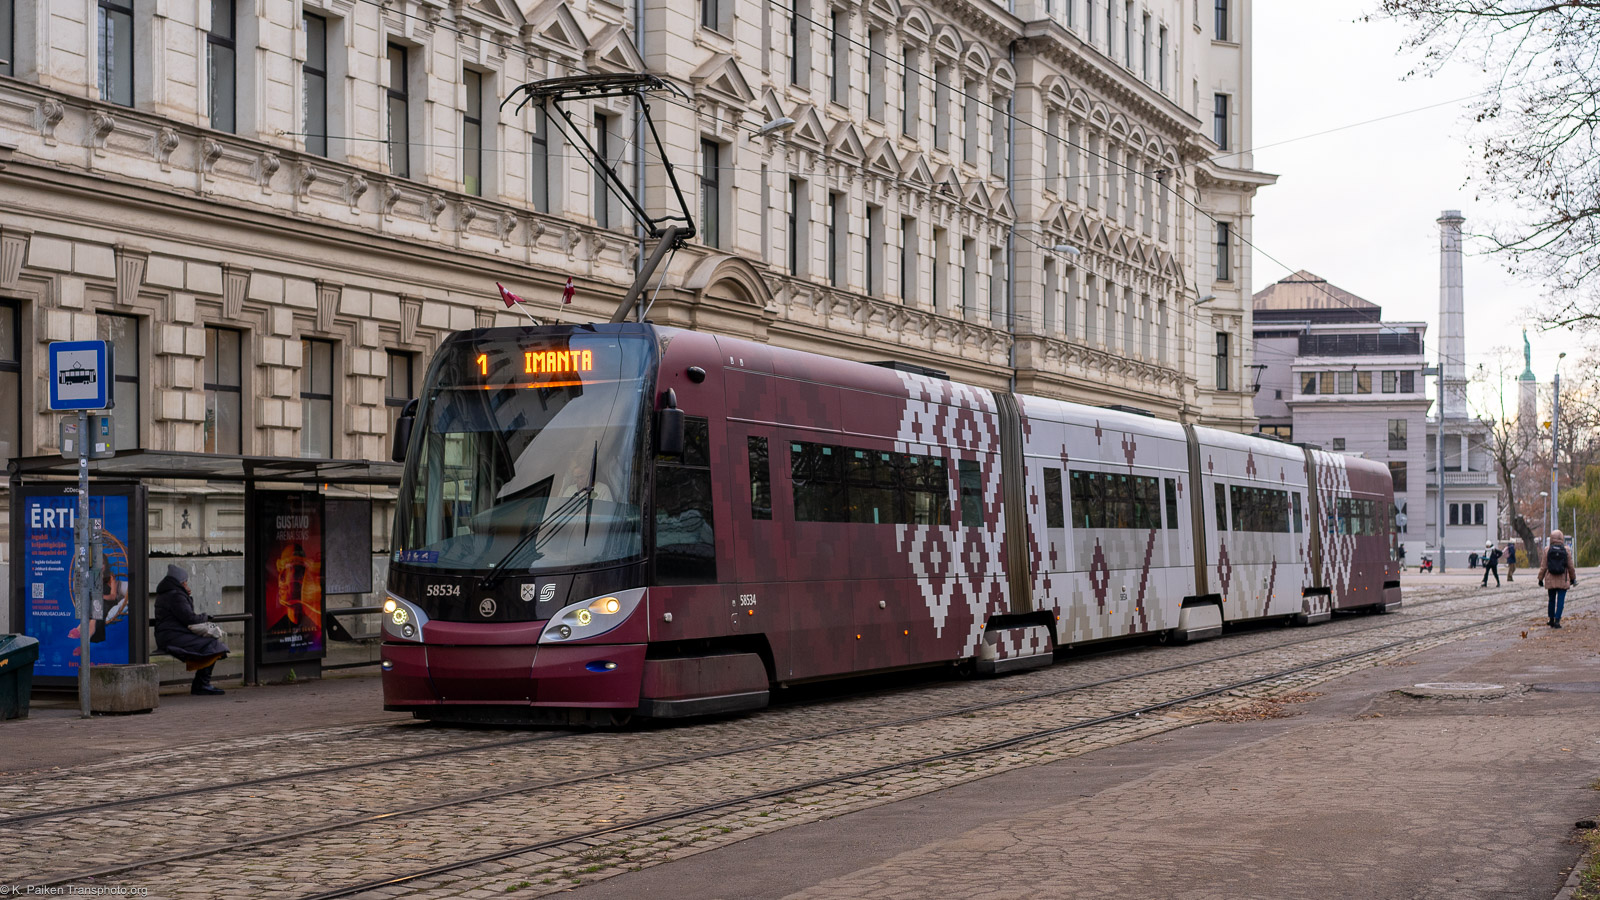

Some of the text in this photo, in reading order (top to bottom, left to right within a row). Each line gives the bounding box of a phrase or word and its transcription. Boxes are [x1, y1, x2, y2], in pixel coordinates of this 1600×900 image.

[476, 350, 593, 375] 1 IMANTA
[31, 503, 75, 529] ĒRTI
[276, 515, 309, 529] GUSTAVO
[426, 584, 461, 597] 58534
[740, 594, 757, 606] 58534
